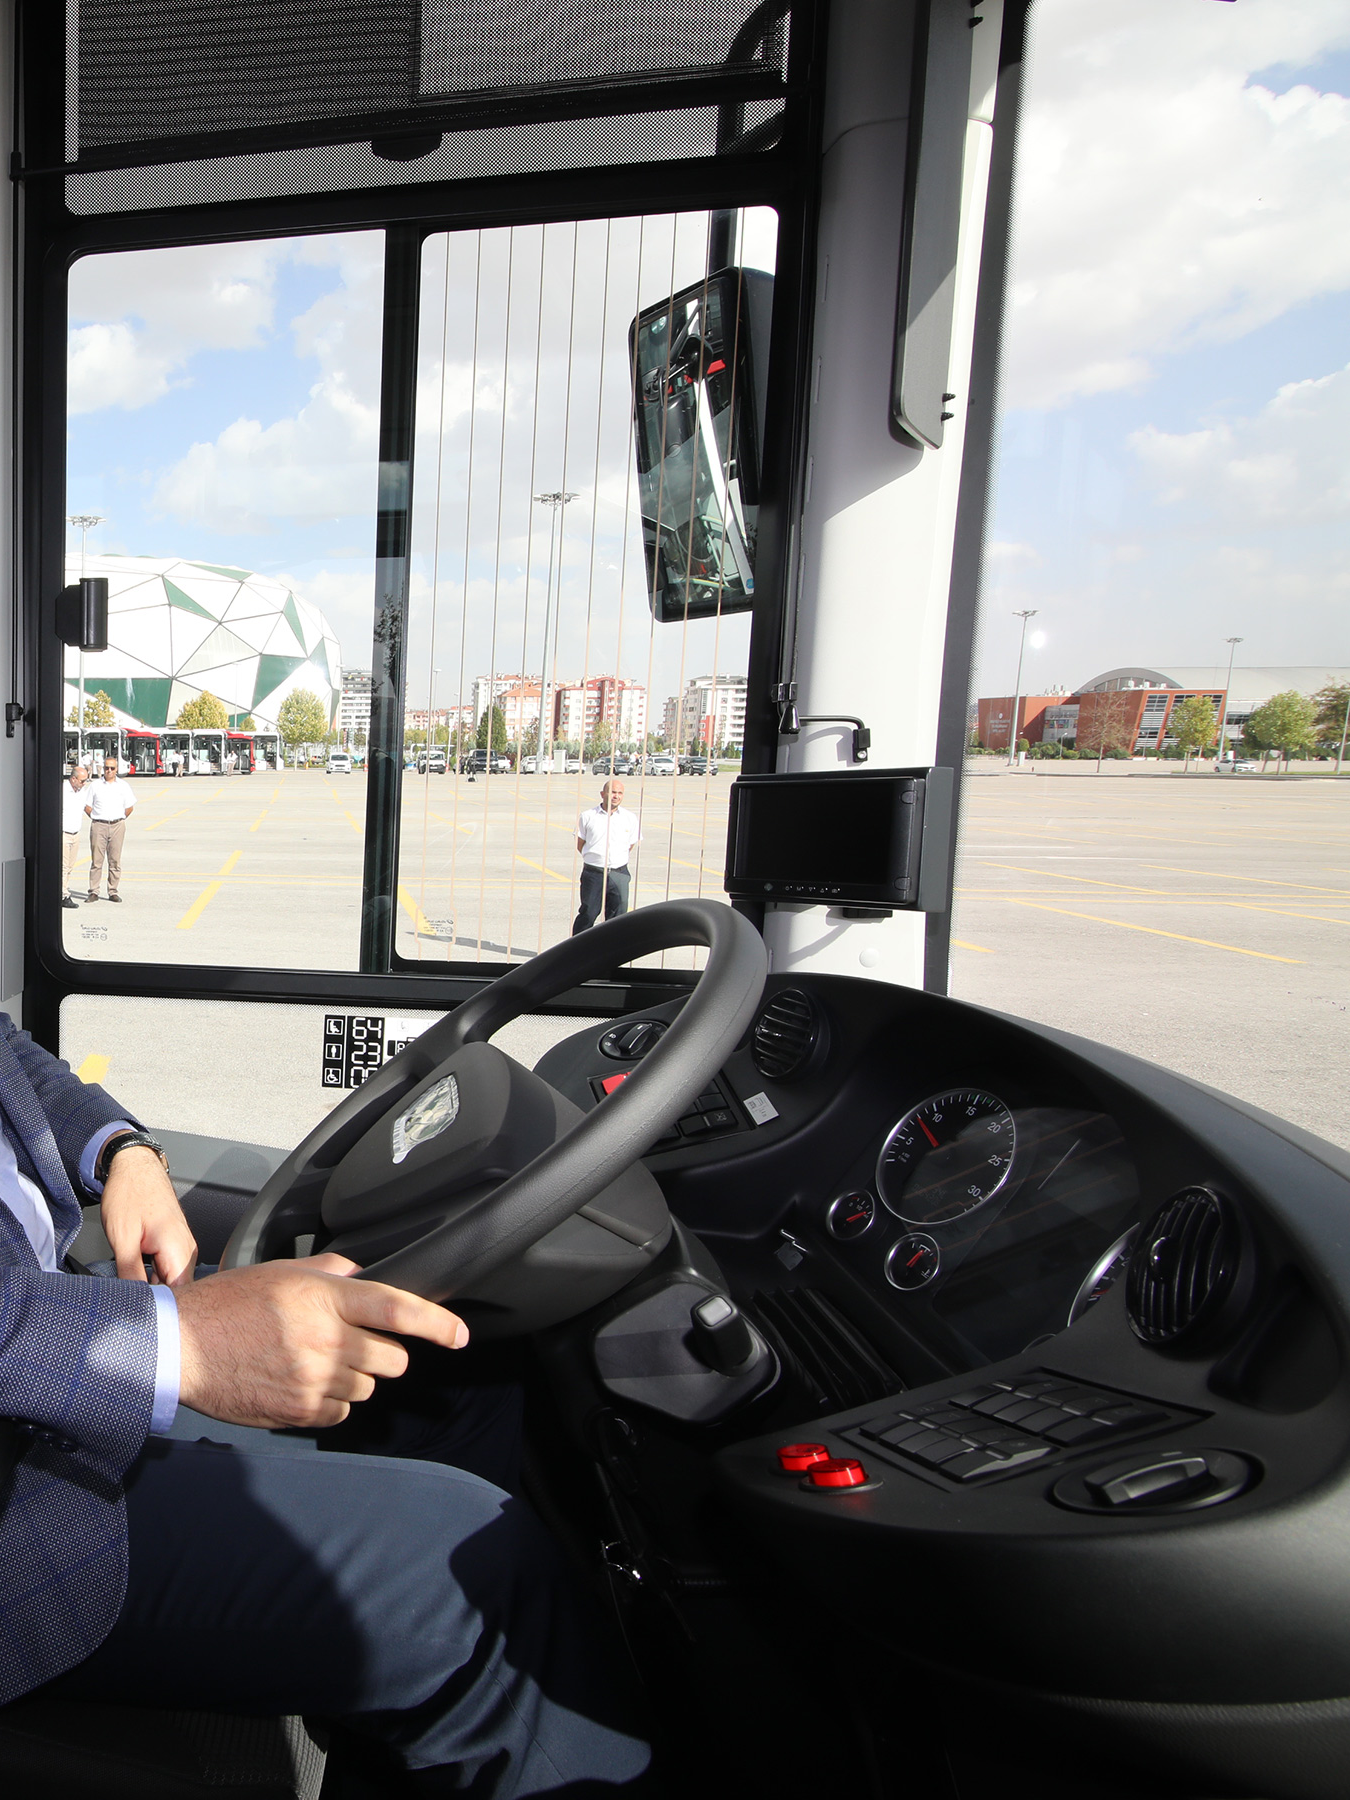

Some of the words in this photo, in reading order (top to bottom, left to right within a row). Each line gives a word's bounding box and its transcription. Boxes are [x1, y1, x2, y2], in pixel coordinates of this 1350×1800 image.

[352, 1017, 382, 1040] 64
[351, 1041, 381, 1065] 23
[965, 1105, 977, 1117] 15
[932, 1112, 943, 1123] 10
[987, 1122, 1001, 1134] 20
[906, 1136, 914, 1146] 5
[987, 1154, 1002, 1167] 25
[967, 1184, 981, 1197] 30
